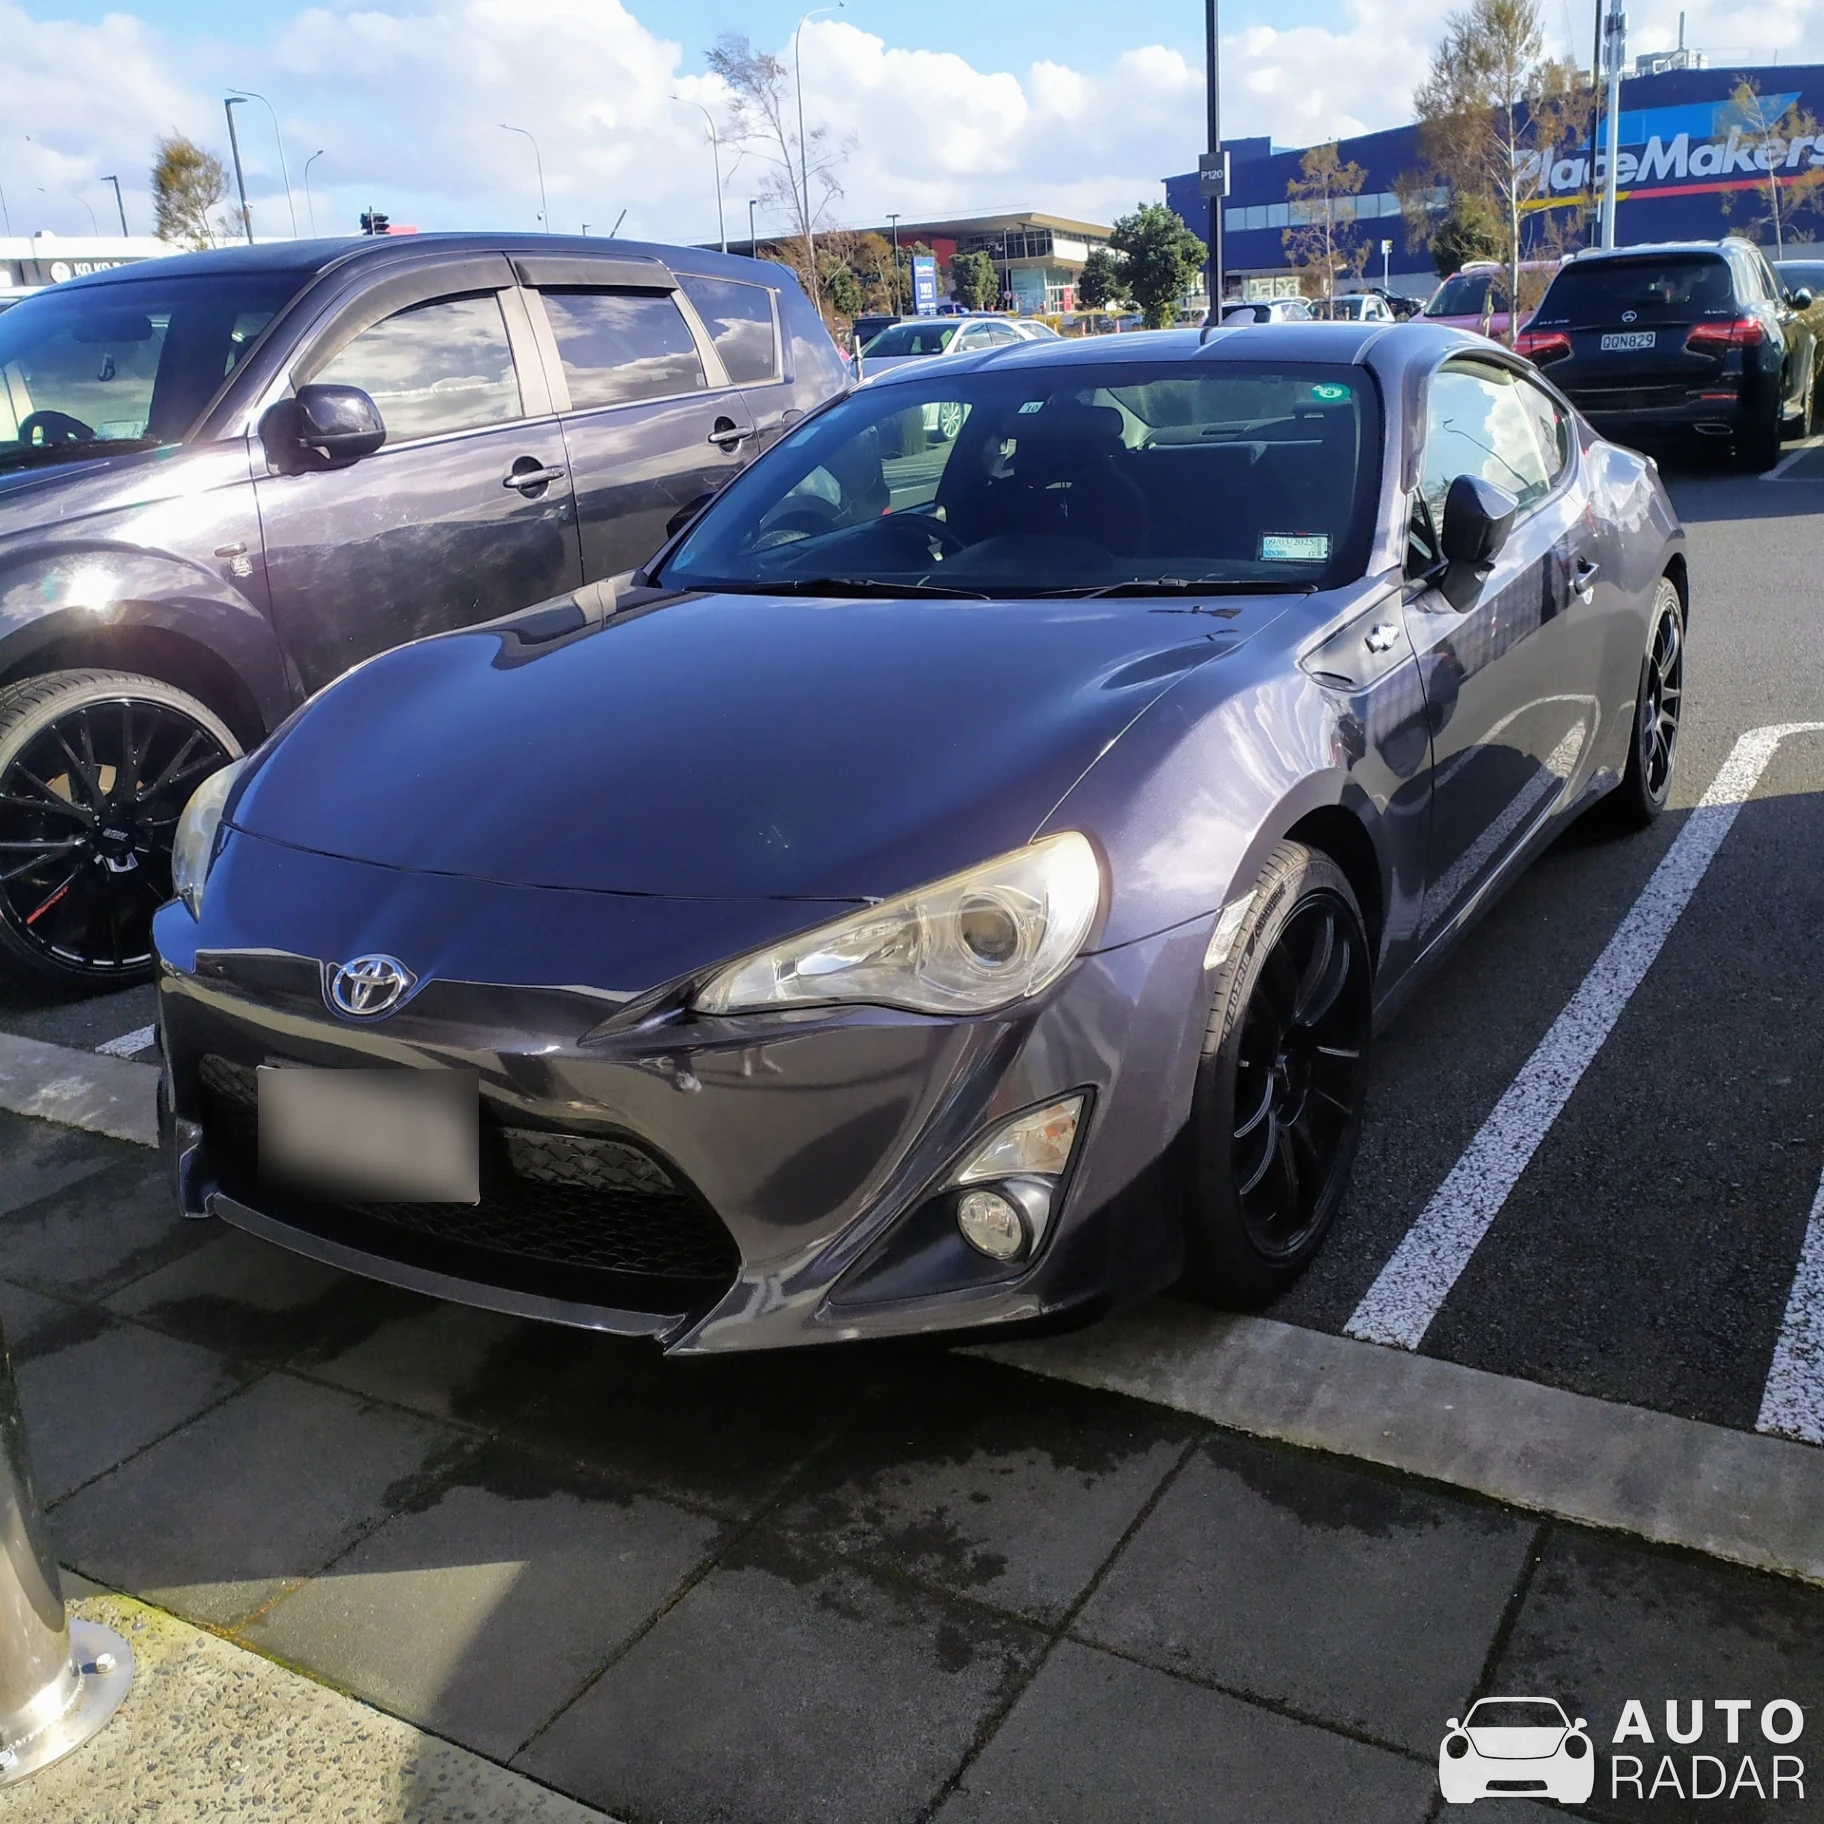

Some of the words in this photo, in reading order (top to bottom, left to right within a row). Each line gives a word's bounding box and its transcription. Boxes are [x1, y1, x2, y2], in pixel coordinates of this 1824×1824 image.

[1201, 169, 1223, 180] P120
[1603, 333, 1653, 349] QQN829
[1265, 538, 1315, 546] 09/03/2025
